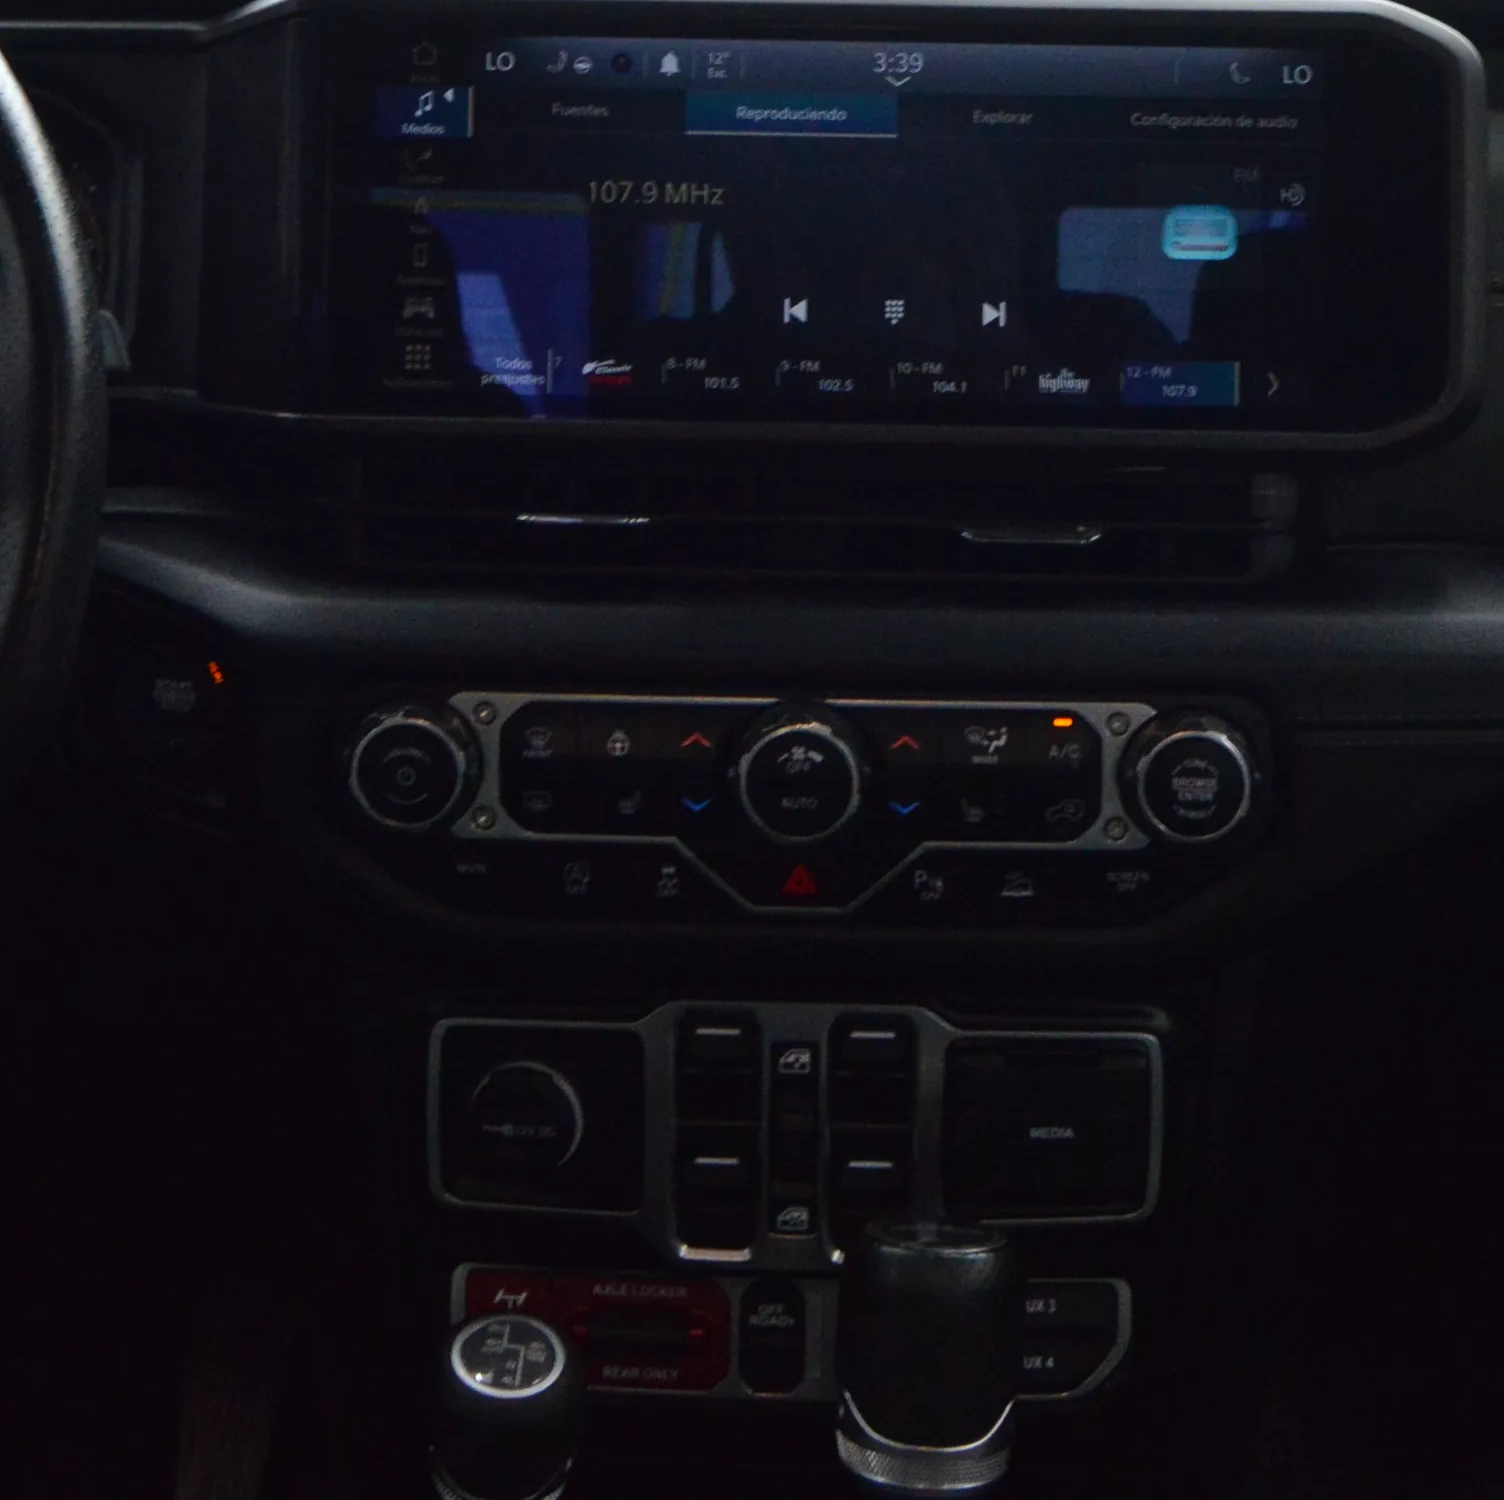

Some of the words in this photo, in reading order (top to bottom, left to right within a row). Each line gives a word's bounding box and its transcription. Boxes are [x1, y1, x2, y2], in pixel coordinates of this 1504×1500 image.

[484, 51, 517, 72] LO
[872, 51, 924, 76] 3:39
[1282, 64, 1314, 85] LO
[551, 102, 610, 118] Fuentes
[735, 104, 848, 122] Reproduciendo
[972, 109, 1033, 127] Explorar
[401, 122, 446, 136] Medios
[1234, 115, 1253, 129] de
[1256, 115, 1300, 130] audio
[588, 180, 660, 205] 107.9
[664, 182, 726, 206] MHz
[1028, 1126, 1076, 1140] MEDIA
[631, 1284, 689, 1299] LOCKER
[1024, 1299, 1047, 1314] UX
[1022, 1356, 1044, 1370] UX
